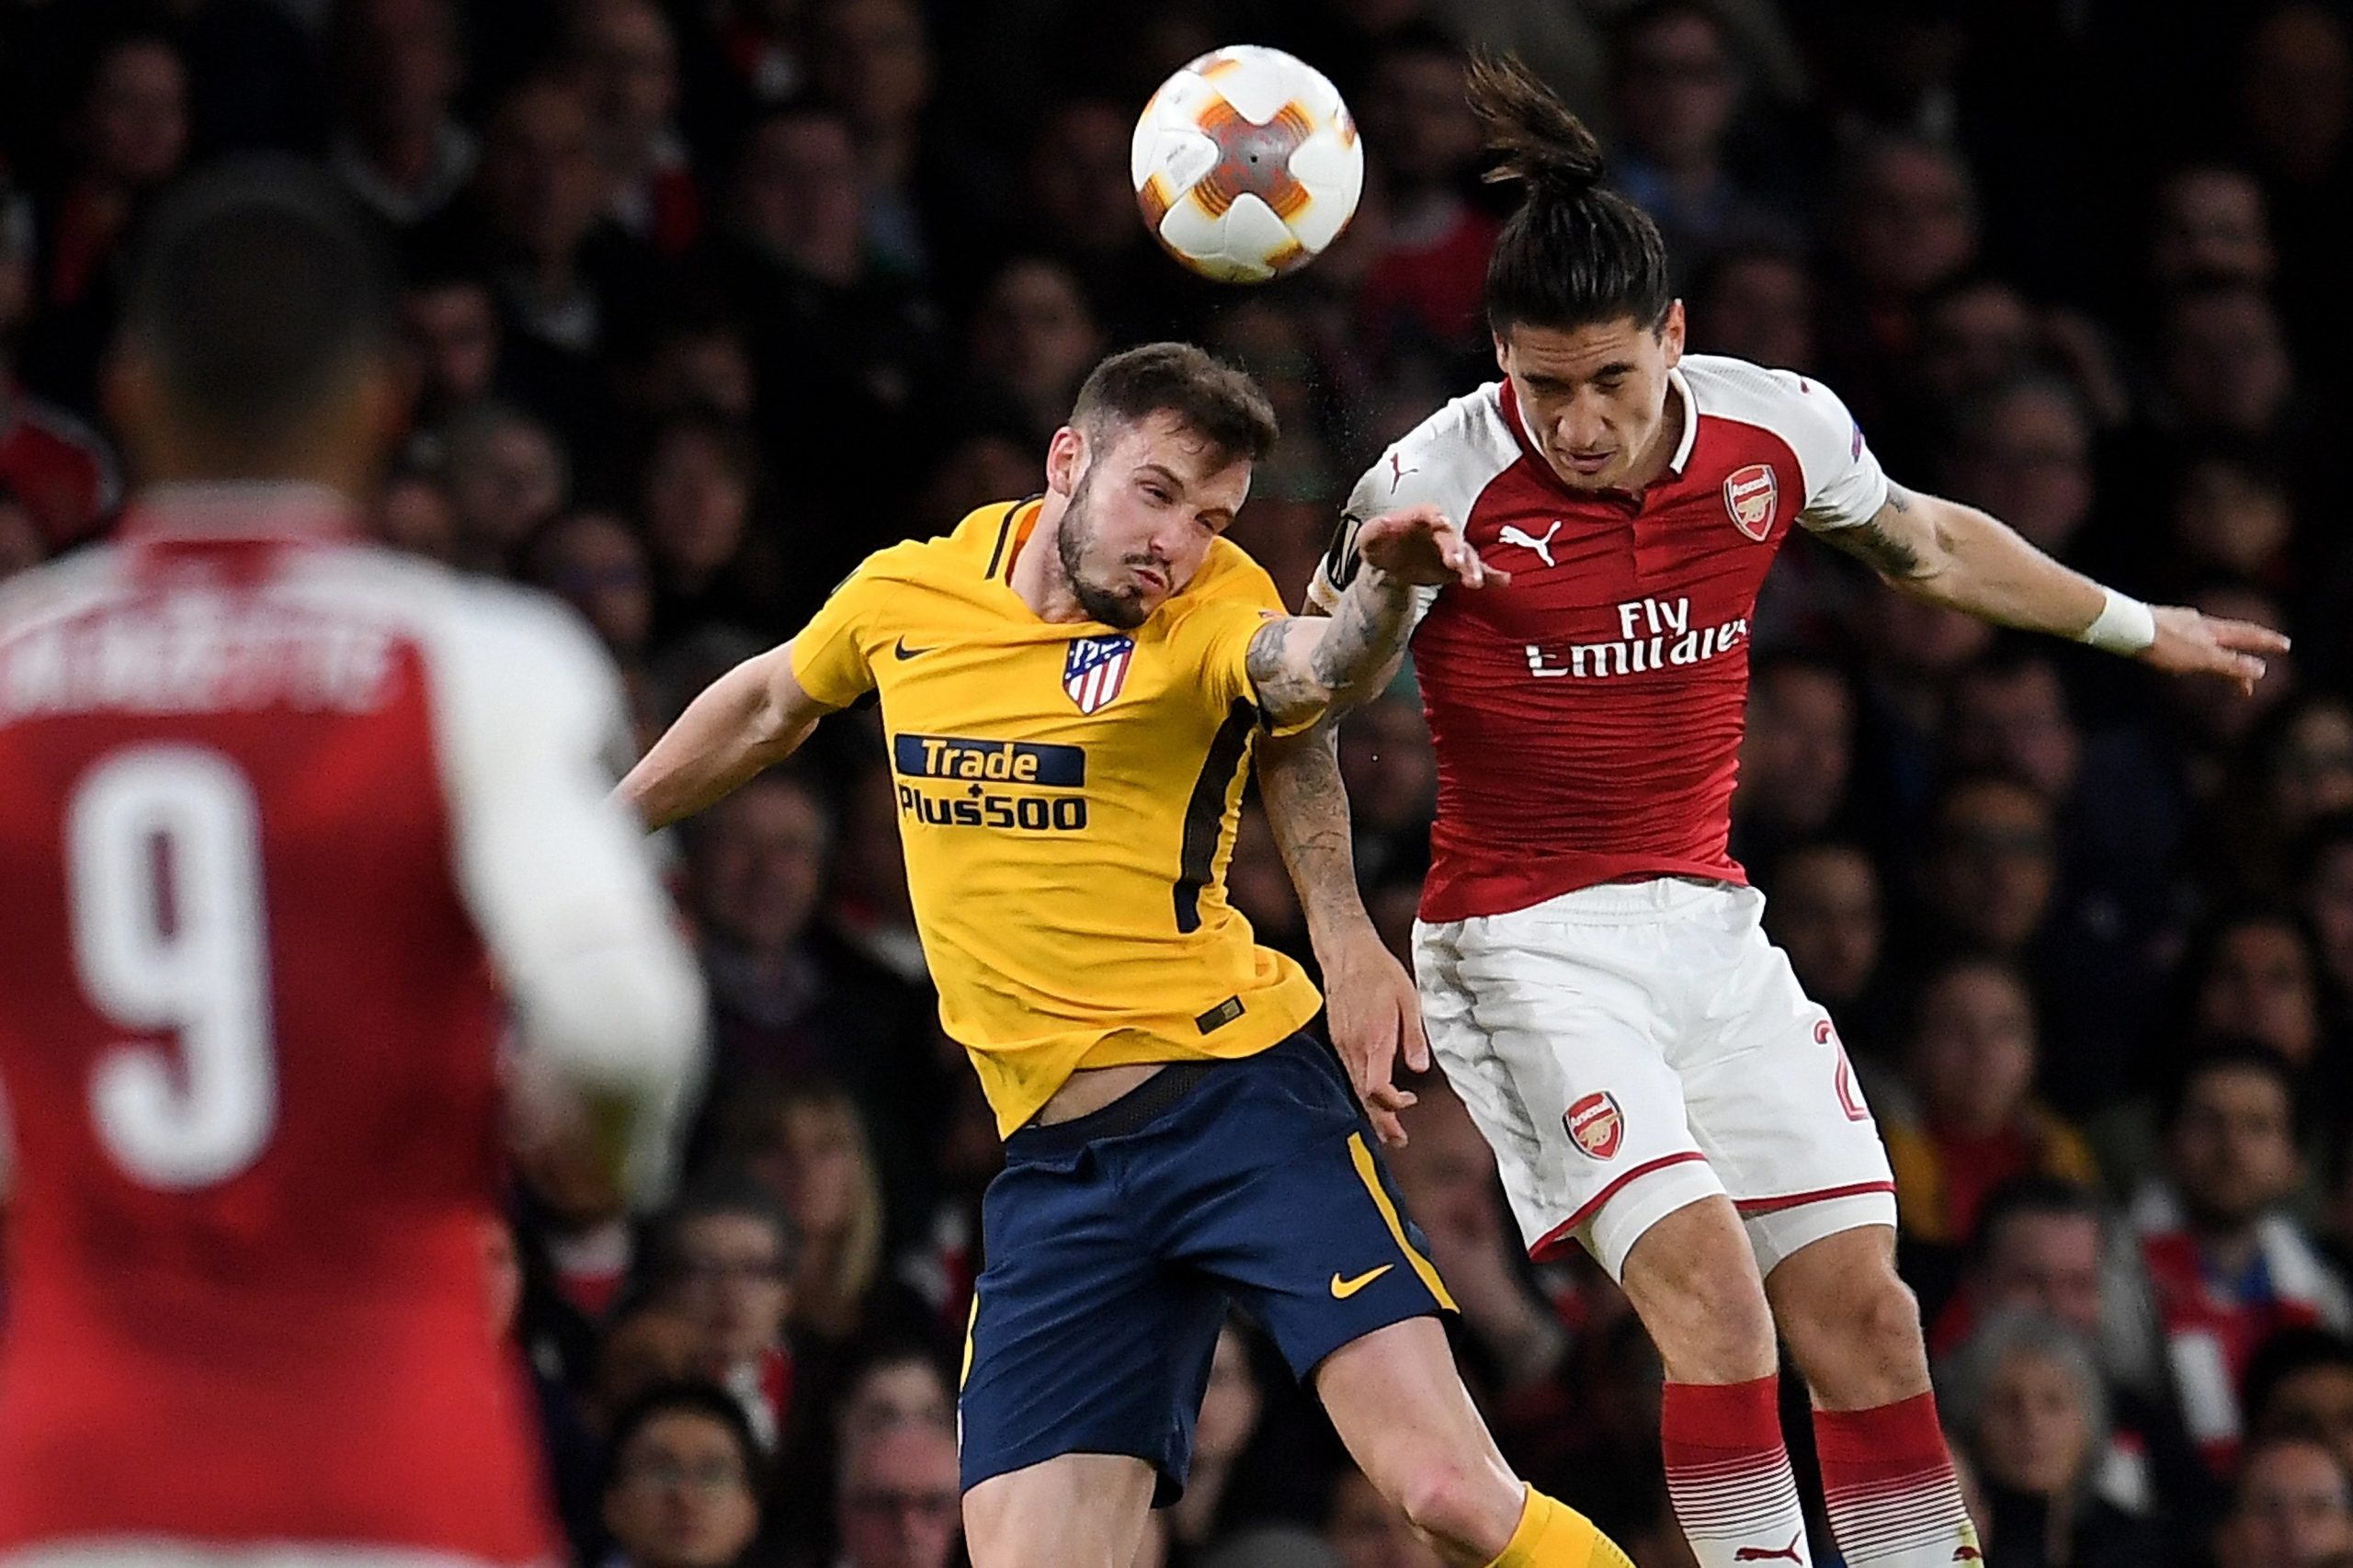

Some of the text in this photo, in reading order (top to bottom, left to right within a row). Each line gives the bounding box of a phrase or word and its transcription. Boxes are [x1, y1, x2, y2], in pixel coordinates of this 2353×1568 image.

[1618, 597, 1688, 640] Fly
[921, 739, 1039, 781] Trade
[898, 784, 1087, 831] Plus500
[66, 741, 278, 1193] 9
